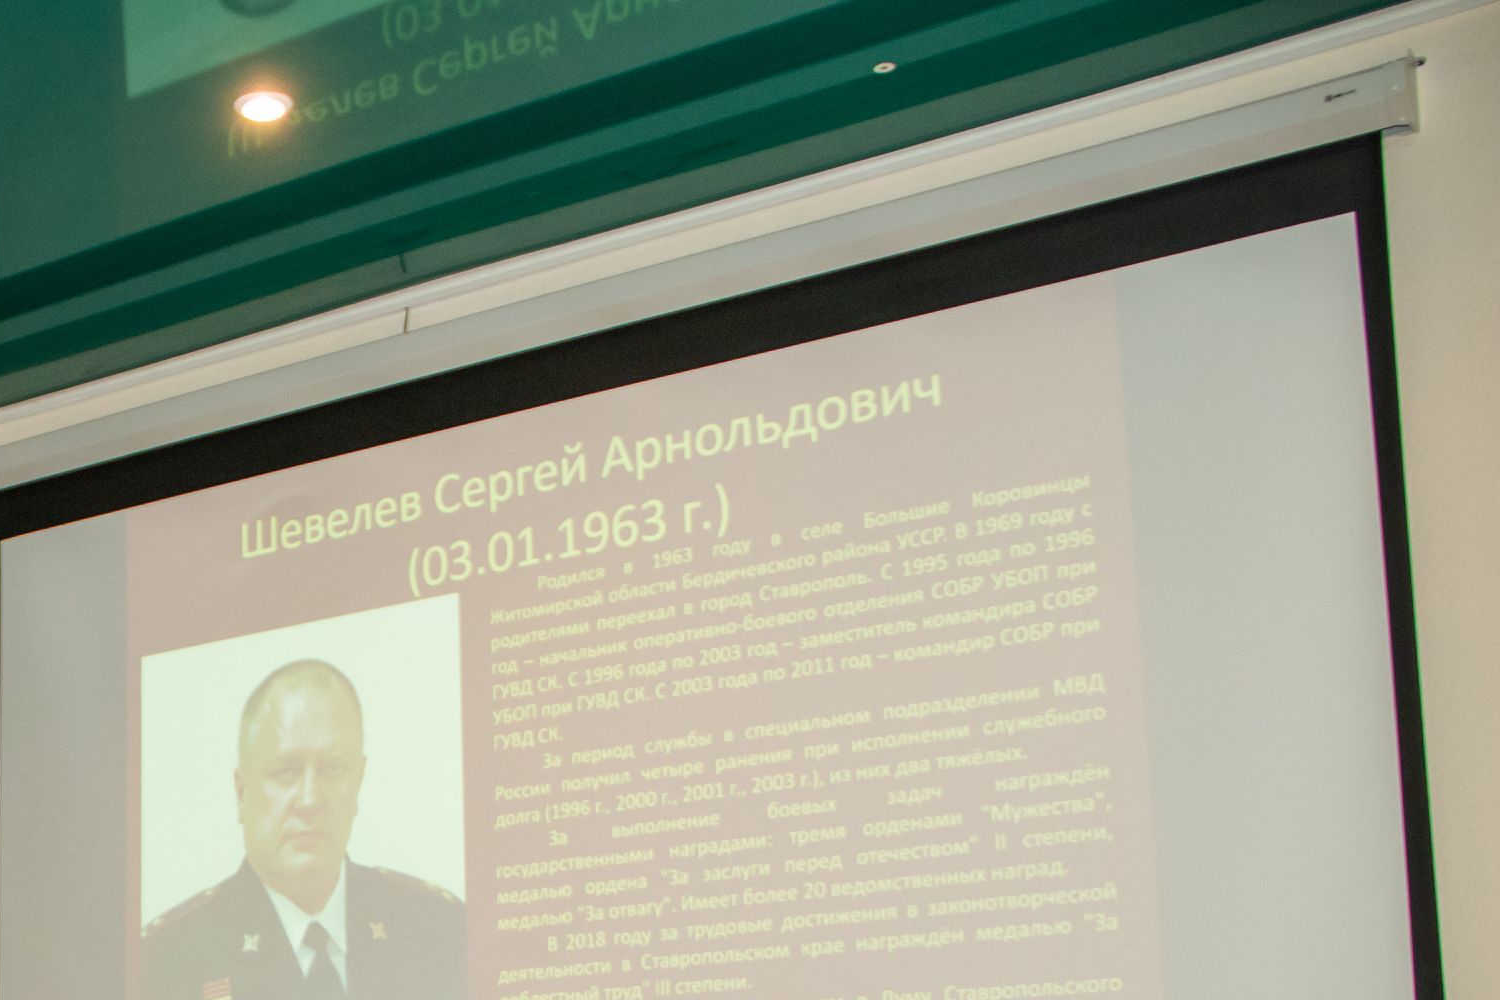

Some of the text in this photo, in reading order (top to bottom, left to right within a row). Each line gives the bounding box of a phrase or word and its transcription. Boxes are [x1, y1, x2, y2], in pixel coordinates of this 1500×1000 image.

[240, 374, 942, 558] Шевелев Сергей Арнольдович
[408, 483, 730, 598] (03.01.1963 г.)
[490, 588, 603, 624] Житомирской
[608, 579, 675, 602] области
[682, 553, 816, 589] Бердичевского
[821, 539, 891, 567] района
[975, 511, 1023, 536] 1969
[1029, 506, 1075, 527] году
[537, 474, 1089, 590] Родился 1963 году селе Большие Коровинцы
[490, 620, 590, 652] родителями
[596, 605, 676, 630] переехал
[700, 591, 753, 612] город
[901, 553, 948, 577] 1995
[956, 548, 1001, 568] года
[1044, 527, 1095, 553] 1996
[491, 560, 1096, 674] год начальник оперативно-боевого отделения СОБР УБОП при
[491, 702, 538, 724] УБОП
[541, 701, 573, 719] при
[576, 689, 621, 712] ГУВД
[671, 675, 713, 697] 2003
[718, 672, 759, 690] года
[790, 656, 834, 679] 2011
[840, 654, 873, 671] год
[893, 635, 996, 663] командир
[999, 621, 1055, 647] СОБР
[1060, 618, 1101, 639] при
[492, 677, 533, 699] ГУВД
[584, 663, 624, 684] 1996
[628, 659, 667, 677] года
[699, 643, 742, 666] 2003
[747, 641, 778, 658] год
[799, 619, 917, 650] заместитель
[922, 599, 1036, 630] командира
[1042, 585, 1098, 611] СОБР
[493, 729, 534, 750] ГУВД
[495, 706, 1106, 801] России получил четыре ранения при исполнении служебного
[543, 673, 1104, 768] За период службы специальном подразделении МВД
[494, 809, 541, 829] долга
[544, 799, 591, 823] (1996
[615, 790, 657, 811] 2000
[682, 782, 723, 803] 2001
[751, 772, 795, 794] 2003
[855, 764, 890, 781] них
[894, 759, 931, 778] два
[549, 829, 567, 846] За
[611, 813, 720, 838] выполнение
[767, 799, 835, 820] боевых
[887, 786, 942, 805] задач
[495, 848, 654, 878] государственными
[788, 826, 847, 848] тремя
[862, 813, 963, 839] орденами
[496, 884, 573, 904] медалью
[584, 876, 647, 897] ордена
[702, 863, 770, 882] заслуги
[784, 855, 842, 875] перед
[995, 833, 1006, 851] II
[497, 911, 573, 930] медалью
[681, 894, 737, 912] Имеет
[743, 888, 798, 906] более
[803, 881, 826, 900] 20
[831, 869, 985, 897] ведомственных
[565, 881, 1117, 950] 2018 году за трудовые достижения законотворческой
[497, 961, 611, 985] деятельности
[640, 945, 790, 970] Ставропольском
[801, 940, 844, 959] крае
[976, 920, 1071, 942] медалью
[655, 979, 670, 996] III
